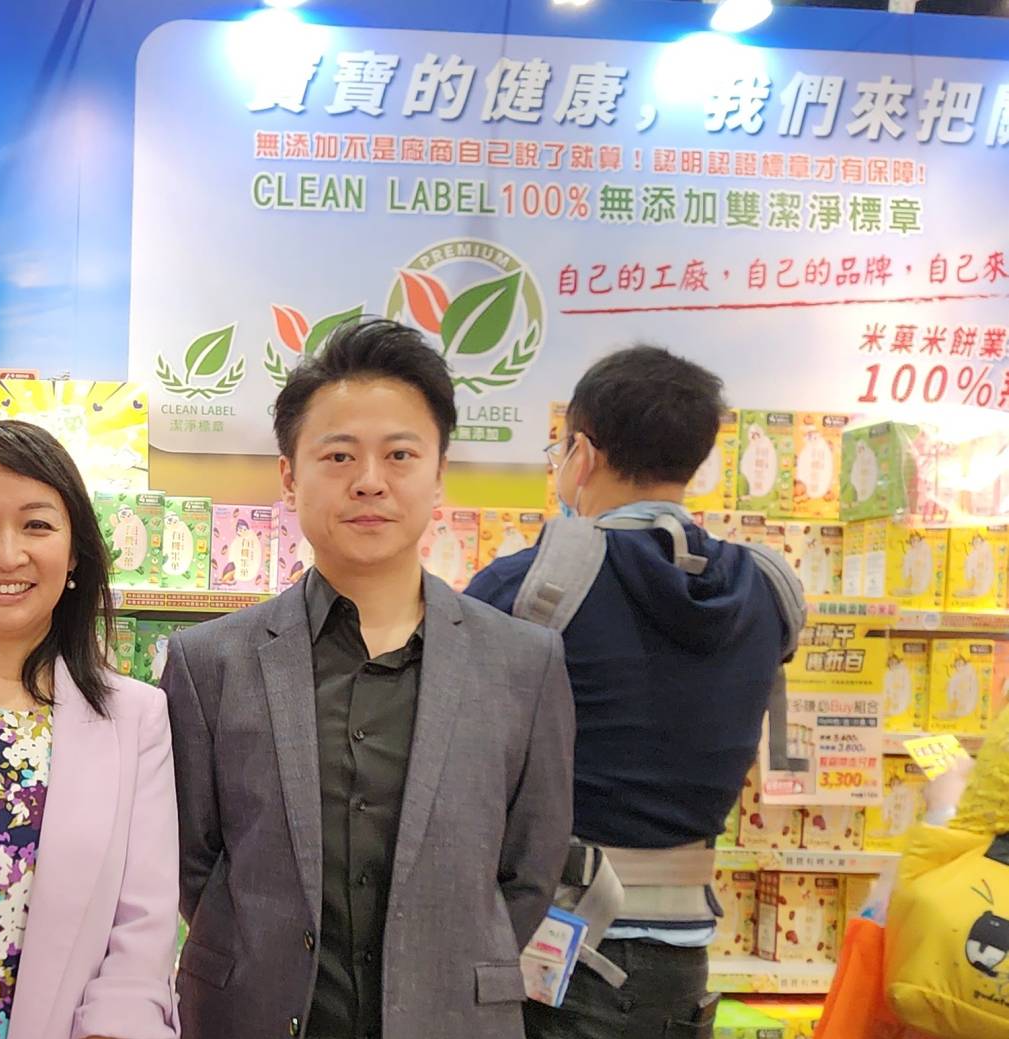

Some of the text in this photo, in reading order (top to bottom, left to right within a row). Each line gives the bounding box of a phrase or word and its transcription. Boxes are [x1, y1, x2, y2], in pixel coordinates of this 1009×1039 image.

[253, 174, 364, 210] CLEAN
[419, 243, 510, 269] PREMIUM
[161, 404, 237, 416] CLEAN LABEL
[466, 406, 523, 422] LABEL
